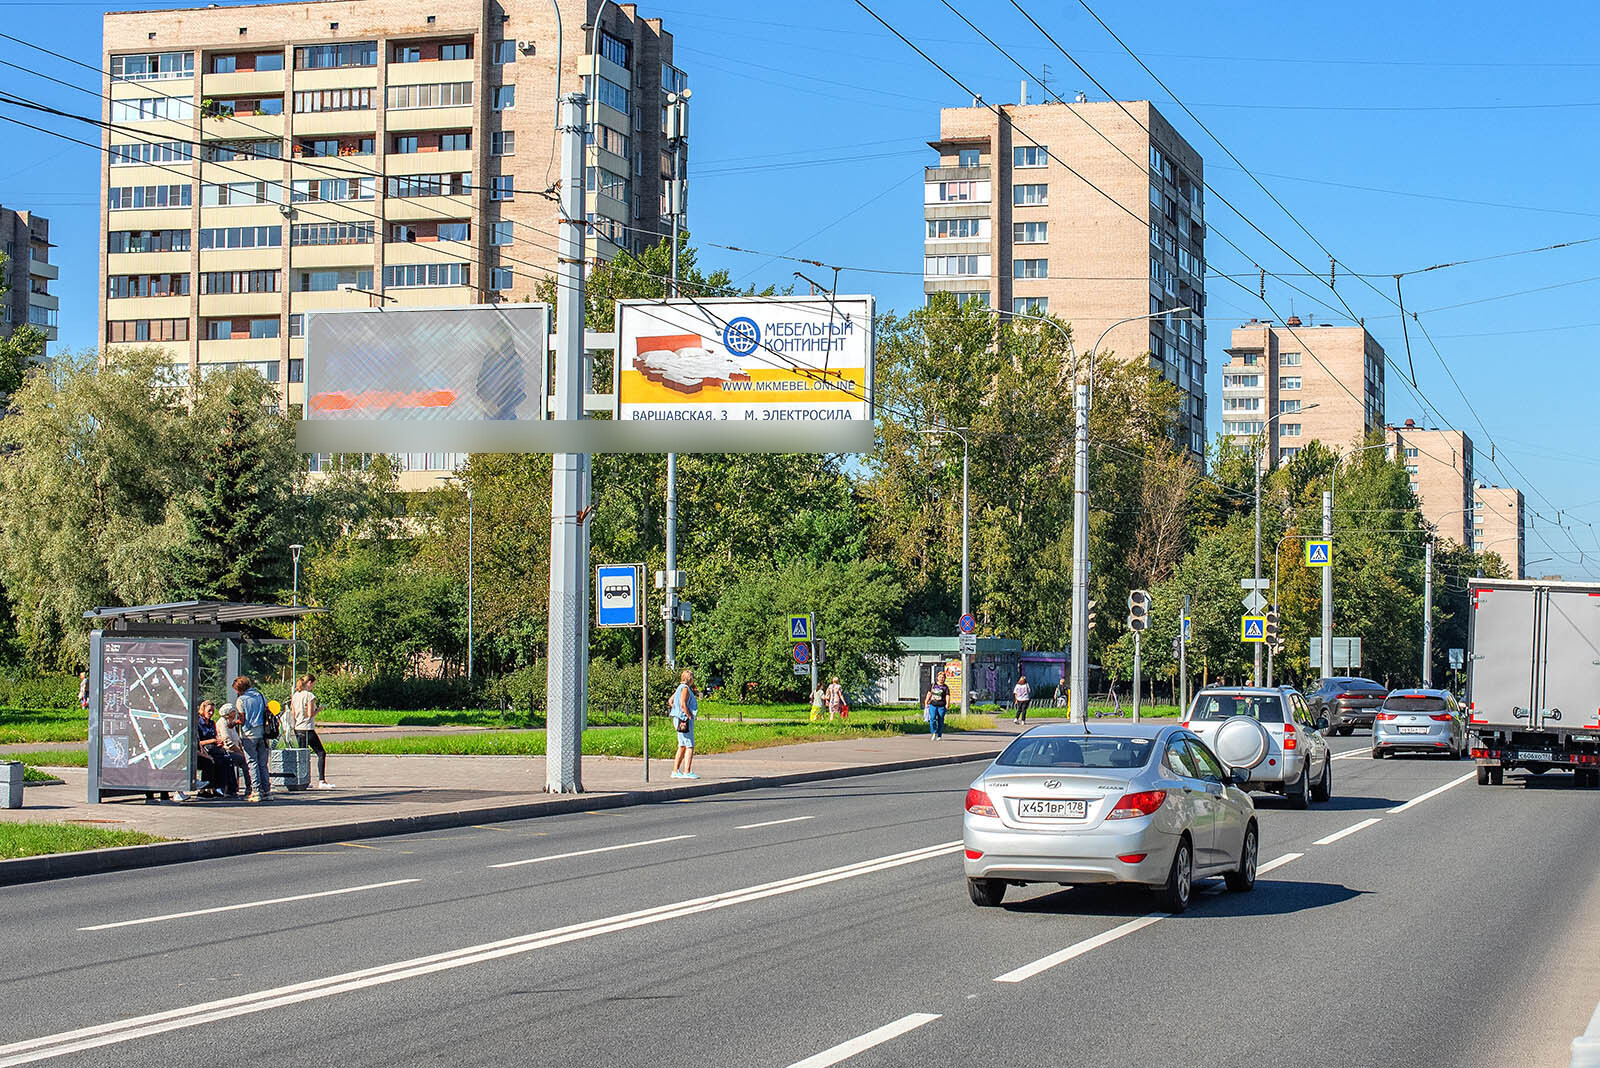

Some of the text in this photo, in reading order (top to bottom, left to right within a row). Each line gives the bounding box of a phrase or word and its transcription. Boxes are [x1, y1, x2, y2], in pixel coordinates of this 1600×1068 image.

[765, 322, 853, 336] МЕБЕЛЬНЫЙ
[765, 338, 846, 352] КОНТИНЕНТ
[722, 381, 855, 391] WWW.MKMEBEL.ONLINE
[721, 410, 728, 420] 3
[763, 409, 852, 420] ЭЛЕКТРОСИЛА
[1023, 802, 1083, 813] Х451ВР 178
